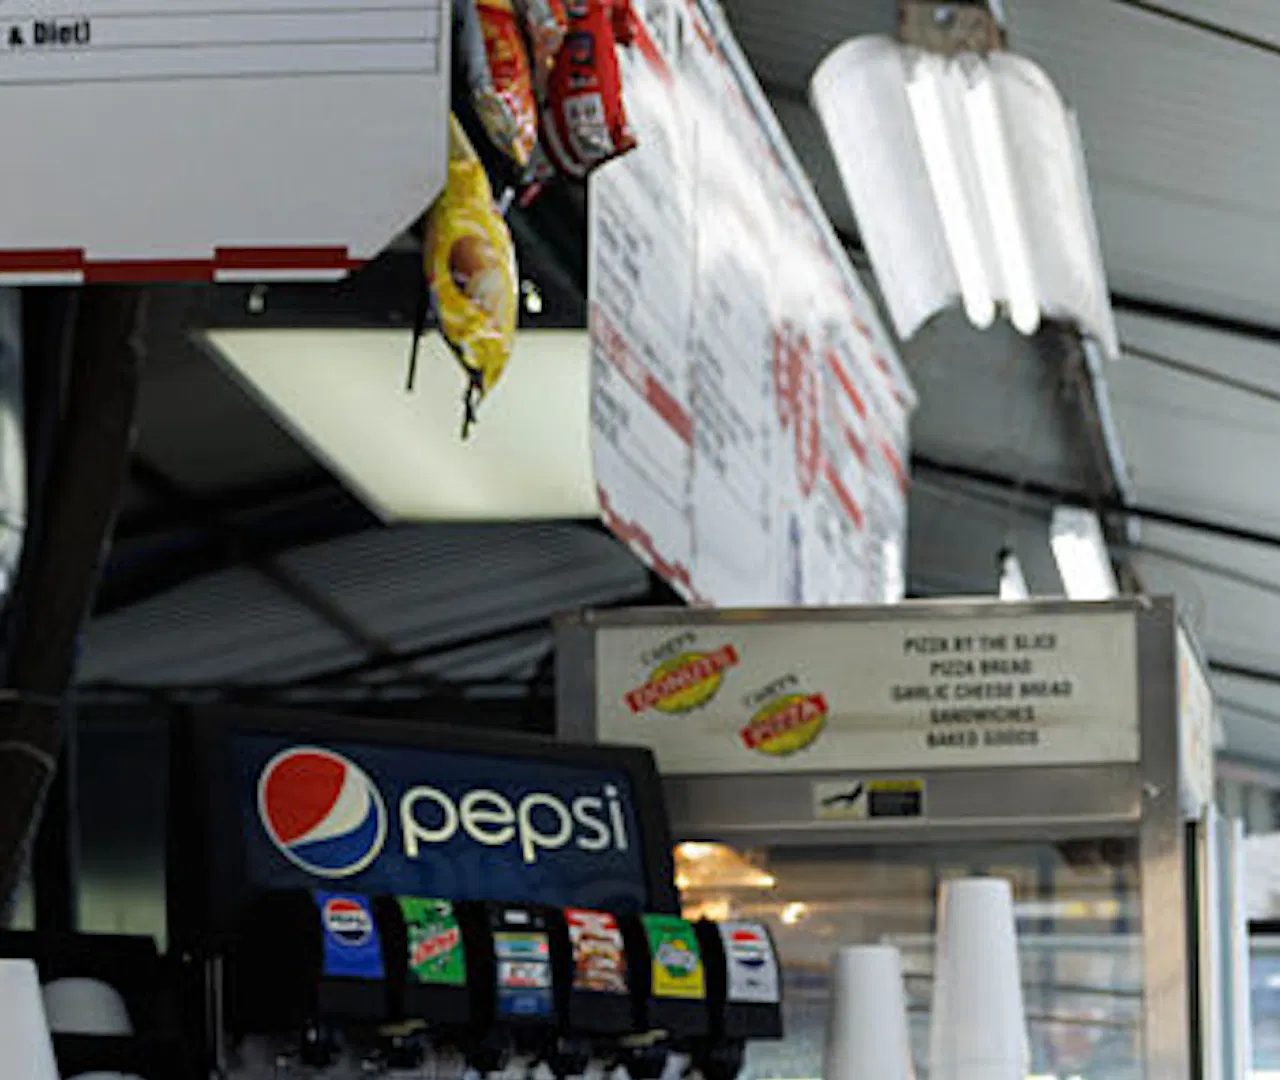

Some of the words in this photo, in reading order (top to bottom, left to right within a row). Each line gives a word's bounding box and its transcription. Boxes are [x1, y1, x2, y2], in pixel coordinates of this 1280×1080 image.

[904, 635, 948, 655] PIZZA
[955, 635, 973, 651] BY
[979, 634, 1006, 652] THE
[1013, 632, 1056, 651] SLICE
[930, 659, 974, 676] PIZZA
[980, 658, 1032, 675] BREAD
[890, 684, 948, 702] GARLIC
[954, 683, 1013, 699] CHEESE
[1020, 680, 1072, 698] BREAD
[930, 704, 1035, 724] SANDWICHES
[926, 729, 979, 747] BAKED
[984, 729, 1038, 747] GOODS
[401, 784, 628, 864] pepsi
